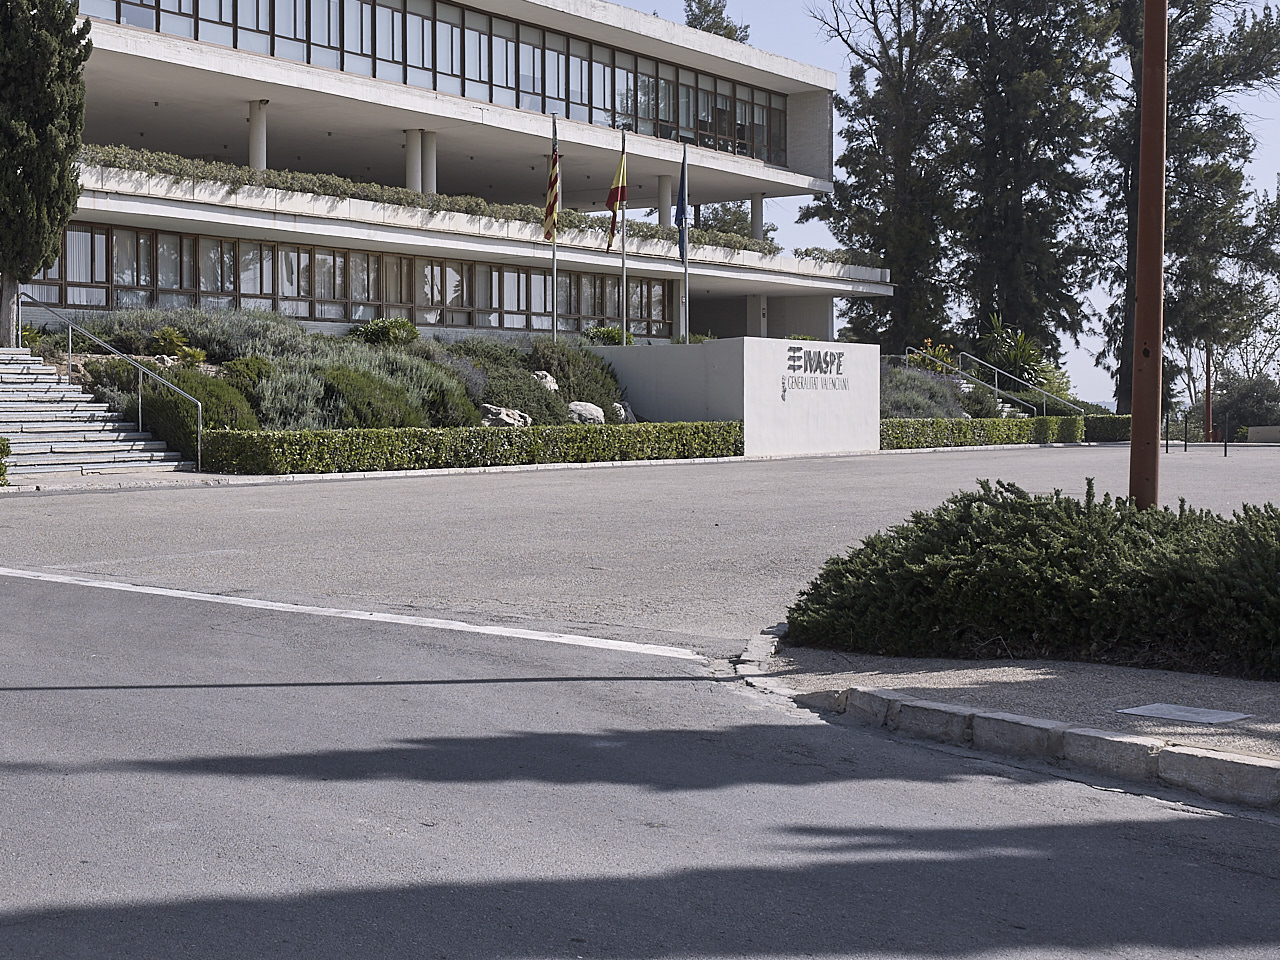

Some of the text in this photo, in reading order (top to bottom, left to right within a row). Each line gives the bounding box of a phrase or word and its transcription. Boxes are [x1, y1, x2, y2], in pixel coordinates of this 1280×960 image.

[803, 350, 845, 375] IVASPE
[787, 376, 850, 391] GENERALITAT VALENCIANA
